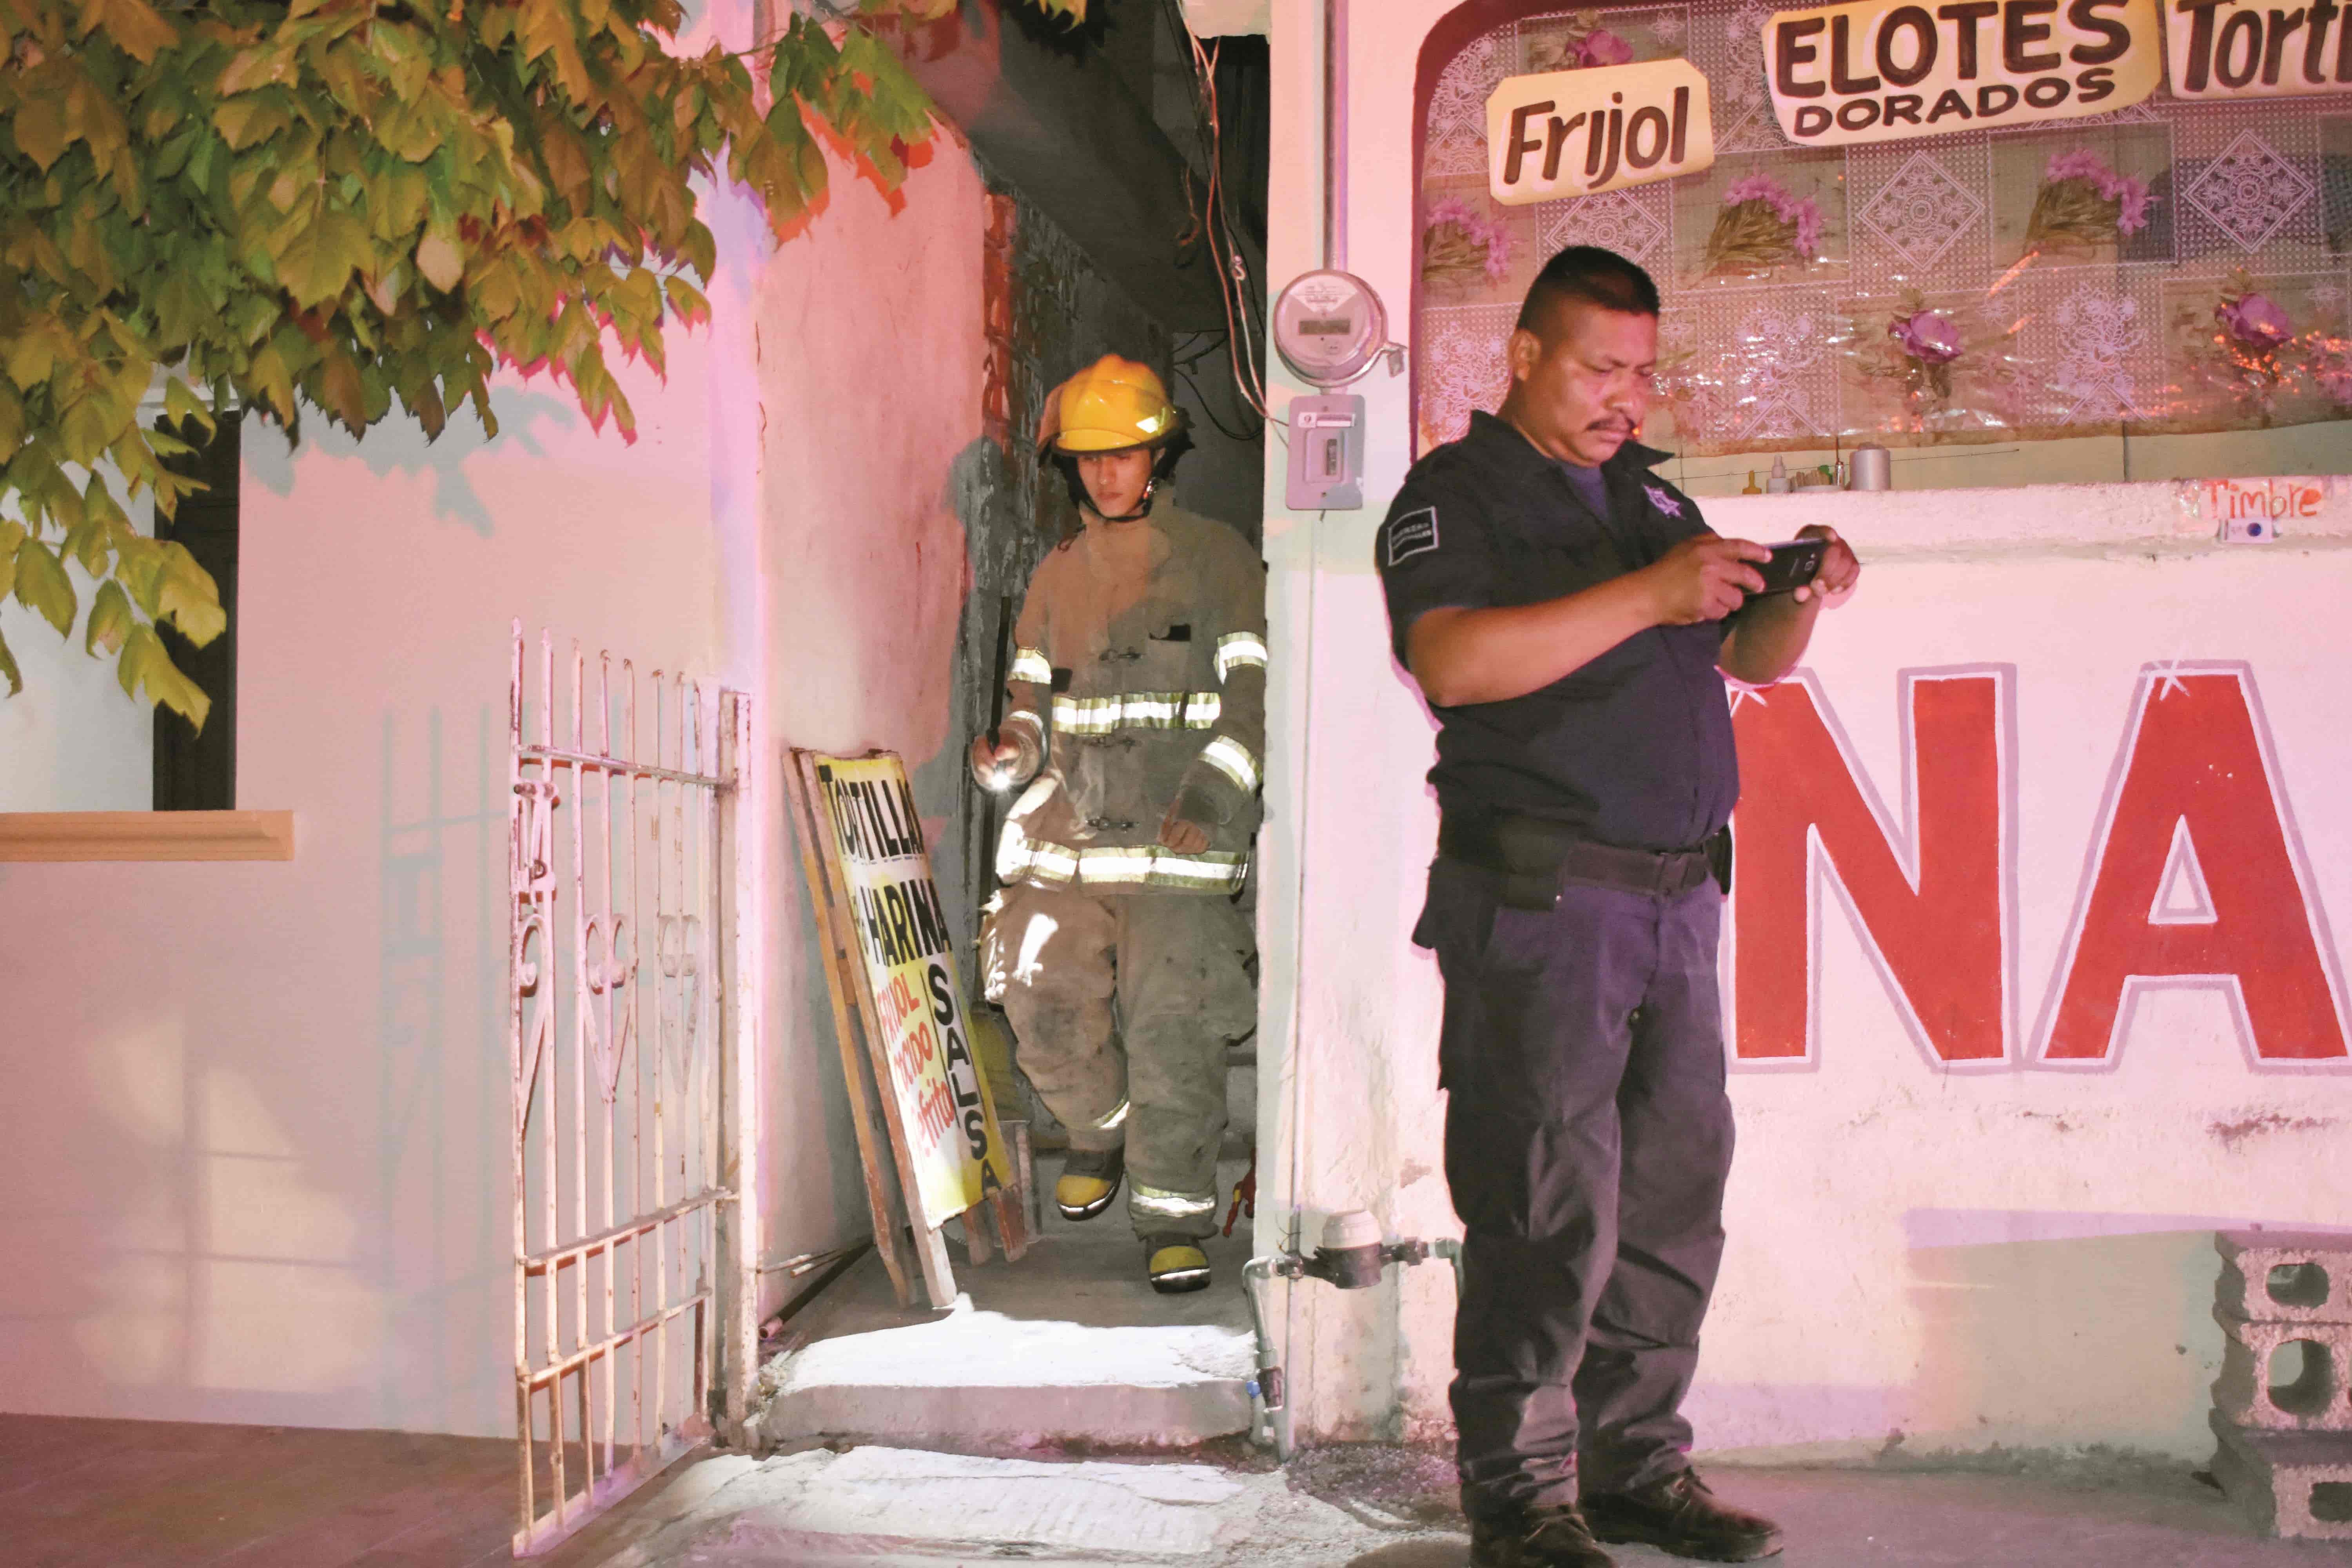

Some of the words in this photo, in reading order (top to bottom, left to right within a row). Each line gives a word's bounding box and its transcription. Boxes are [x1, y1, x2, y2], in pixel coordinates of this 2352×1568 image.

[1776, 0, 2130, 97] ELOTES
[1504, 86, 1689, 189] Frijol
[1794, 68, 2115, 137] DORADOS
[2201, 479, 2321, 519] Timbre
[860, 878, 953, 967] HARINA
